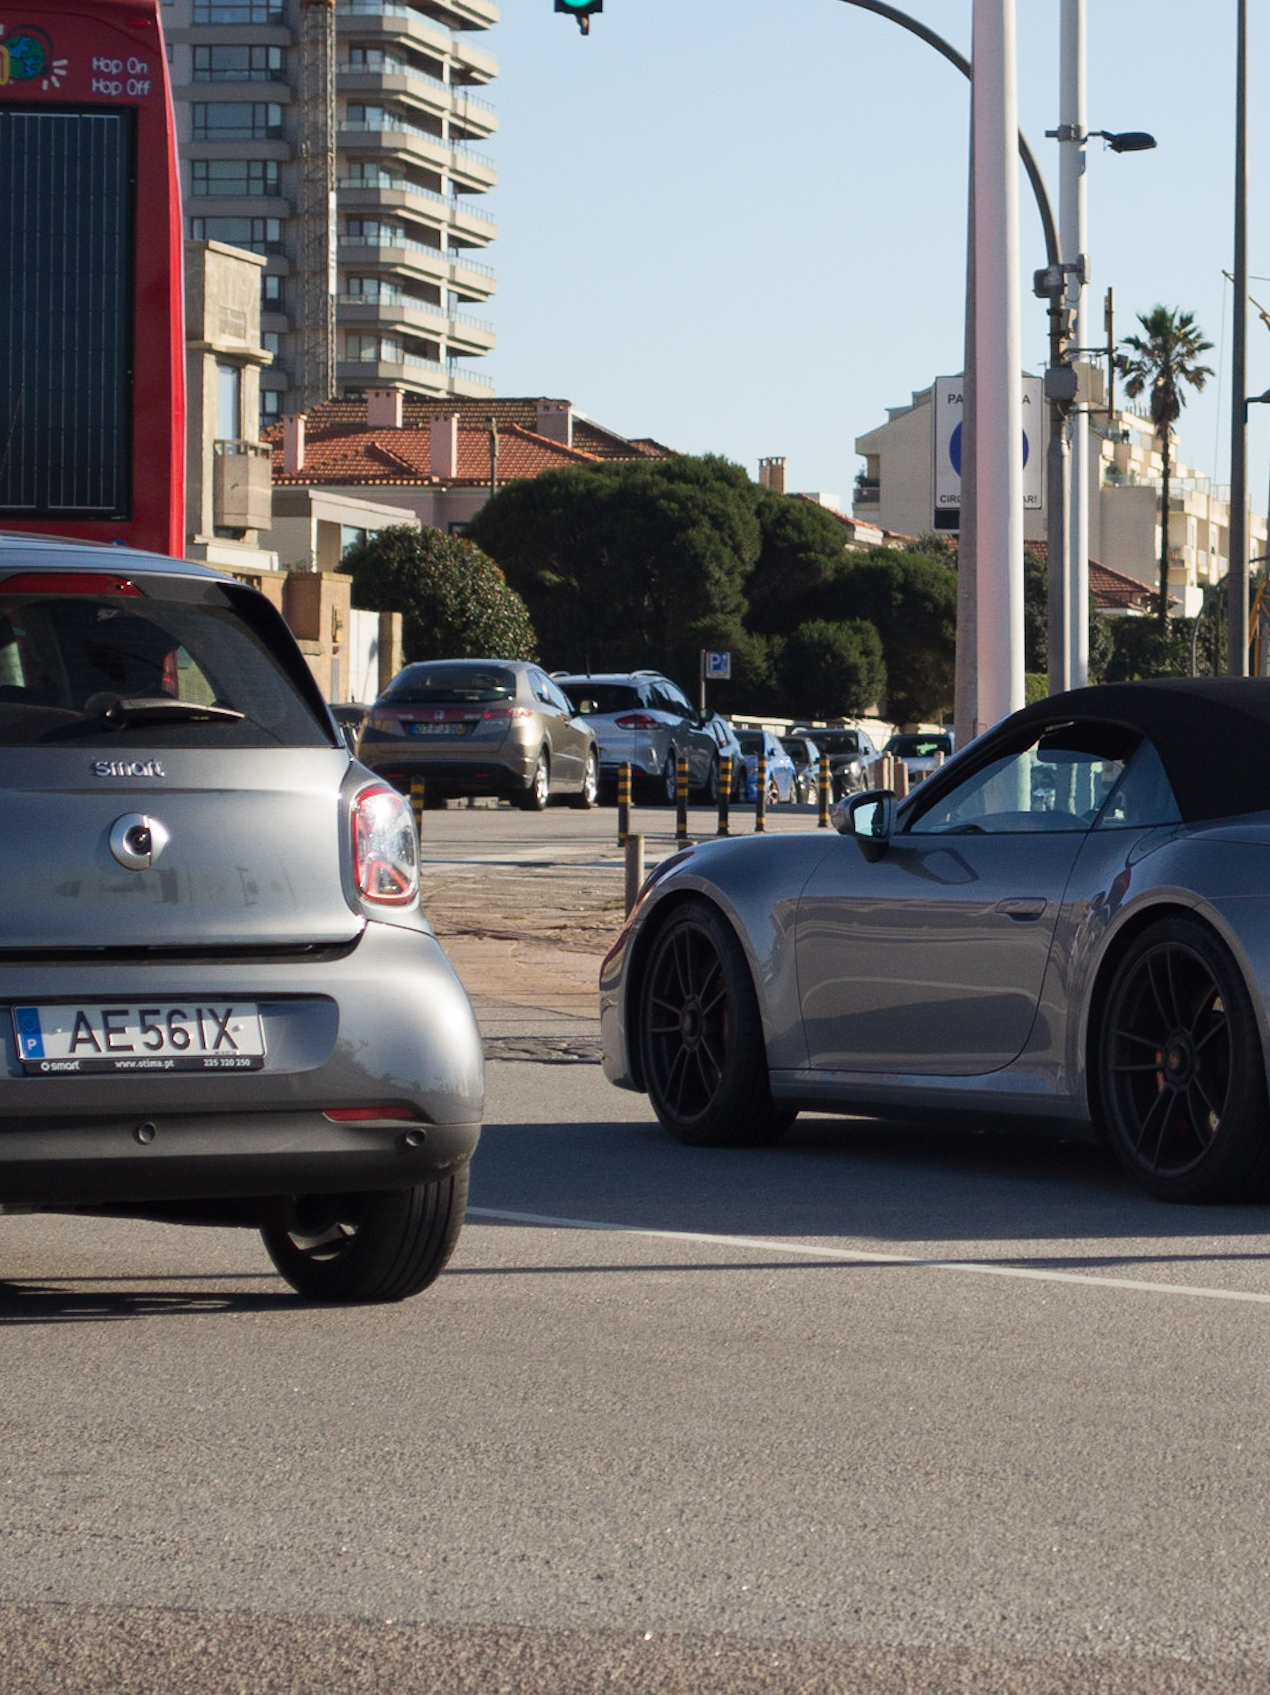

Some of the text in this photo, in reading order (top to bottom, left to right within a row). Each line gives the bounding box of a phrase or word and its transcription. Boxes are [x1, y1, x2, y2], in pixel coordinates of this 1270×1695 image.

[92, 57, 147, 74] Hop On
[92, 79, 150, 95] Hop Off
[94, 759, 165, 778] smart
[50, 1059, 80, 1071] smart
[114, 1058, 175, 1070] www.otima.pt
